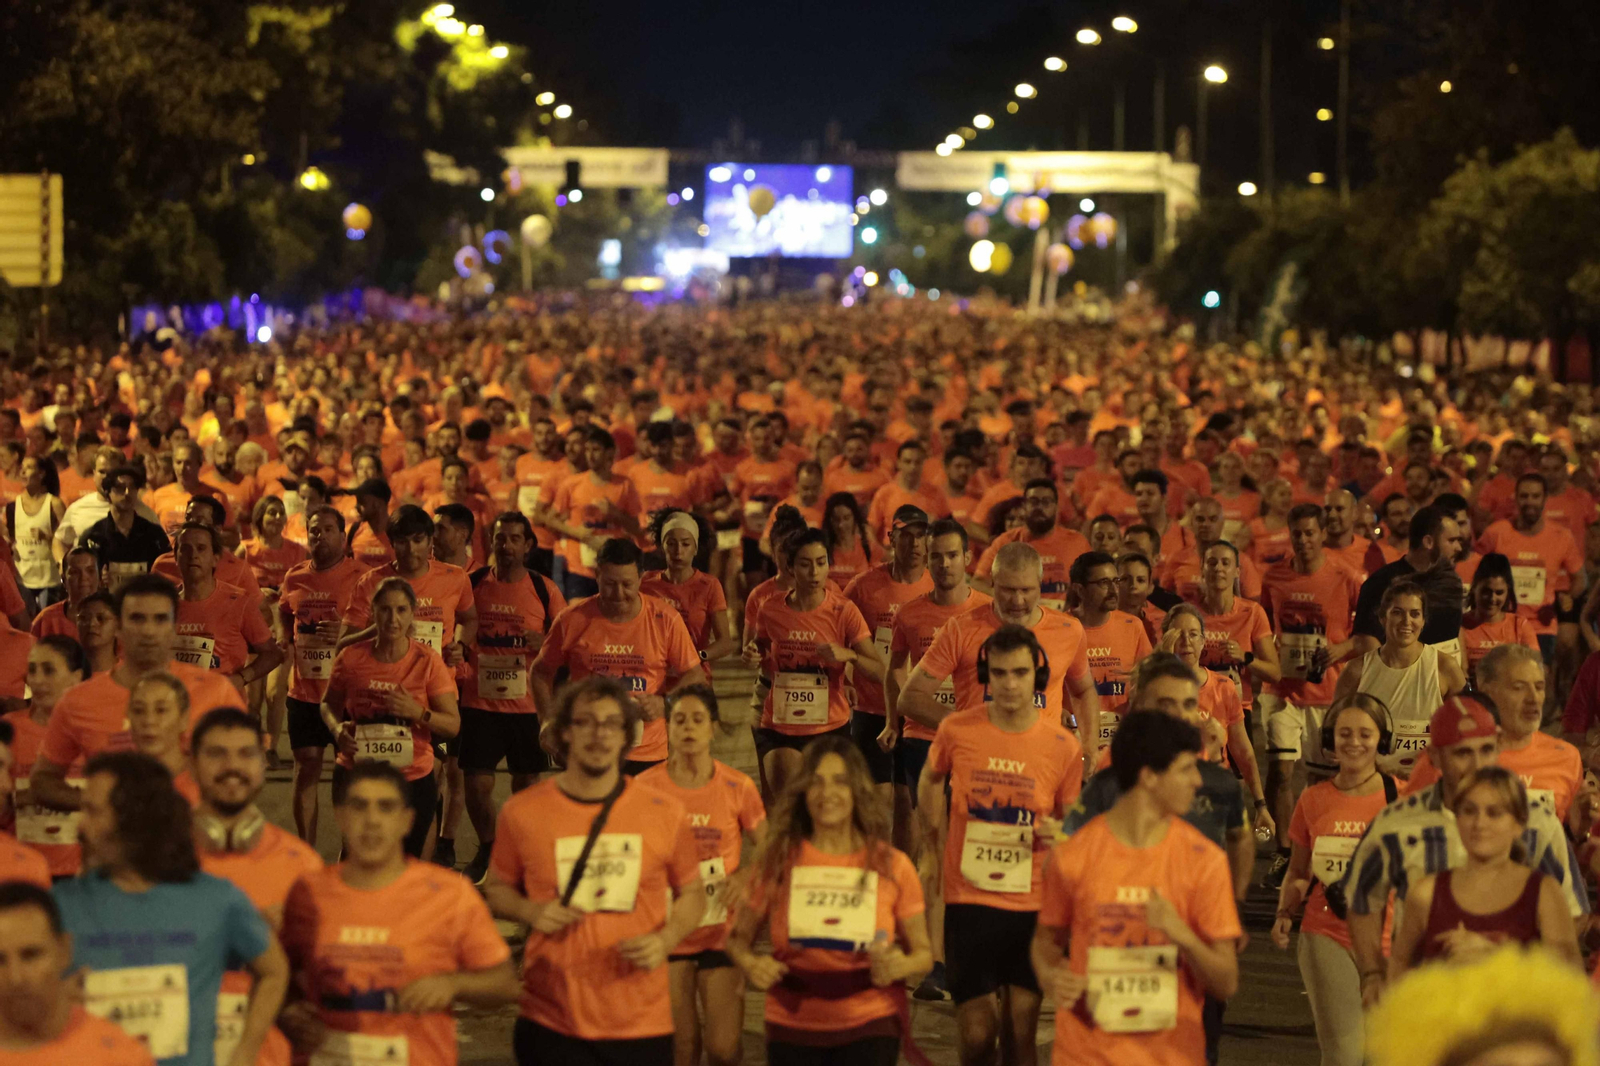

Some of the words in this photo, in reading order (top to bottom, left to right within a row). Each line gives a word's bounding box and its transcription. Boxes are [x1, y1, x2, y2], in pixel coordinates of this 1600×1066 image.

[788, 630, 816, 641] XXXV
[605, 644, 635, 655] XXXV
[302, 650, 332, 661] 20064
[485, 670, 518, 681] 20055
[784, 691, 814, 703] 7950
[364, 742, 403, 754] 13640
[987, 757, 1026, 775] XXXV
[976, 846, 1020, 864] 21421
